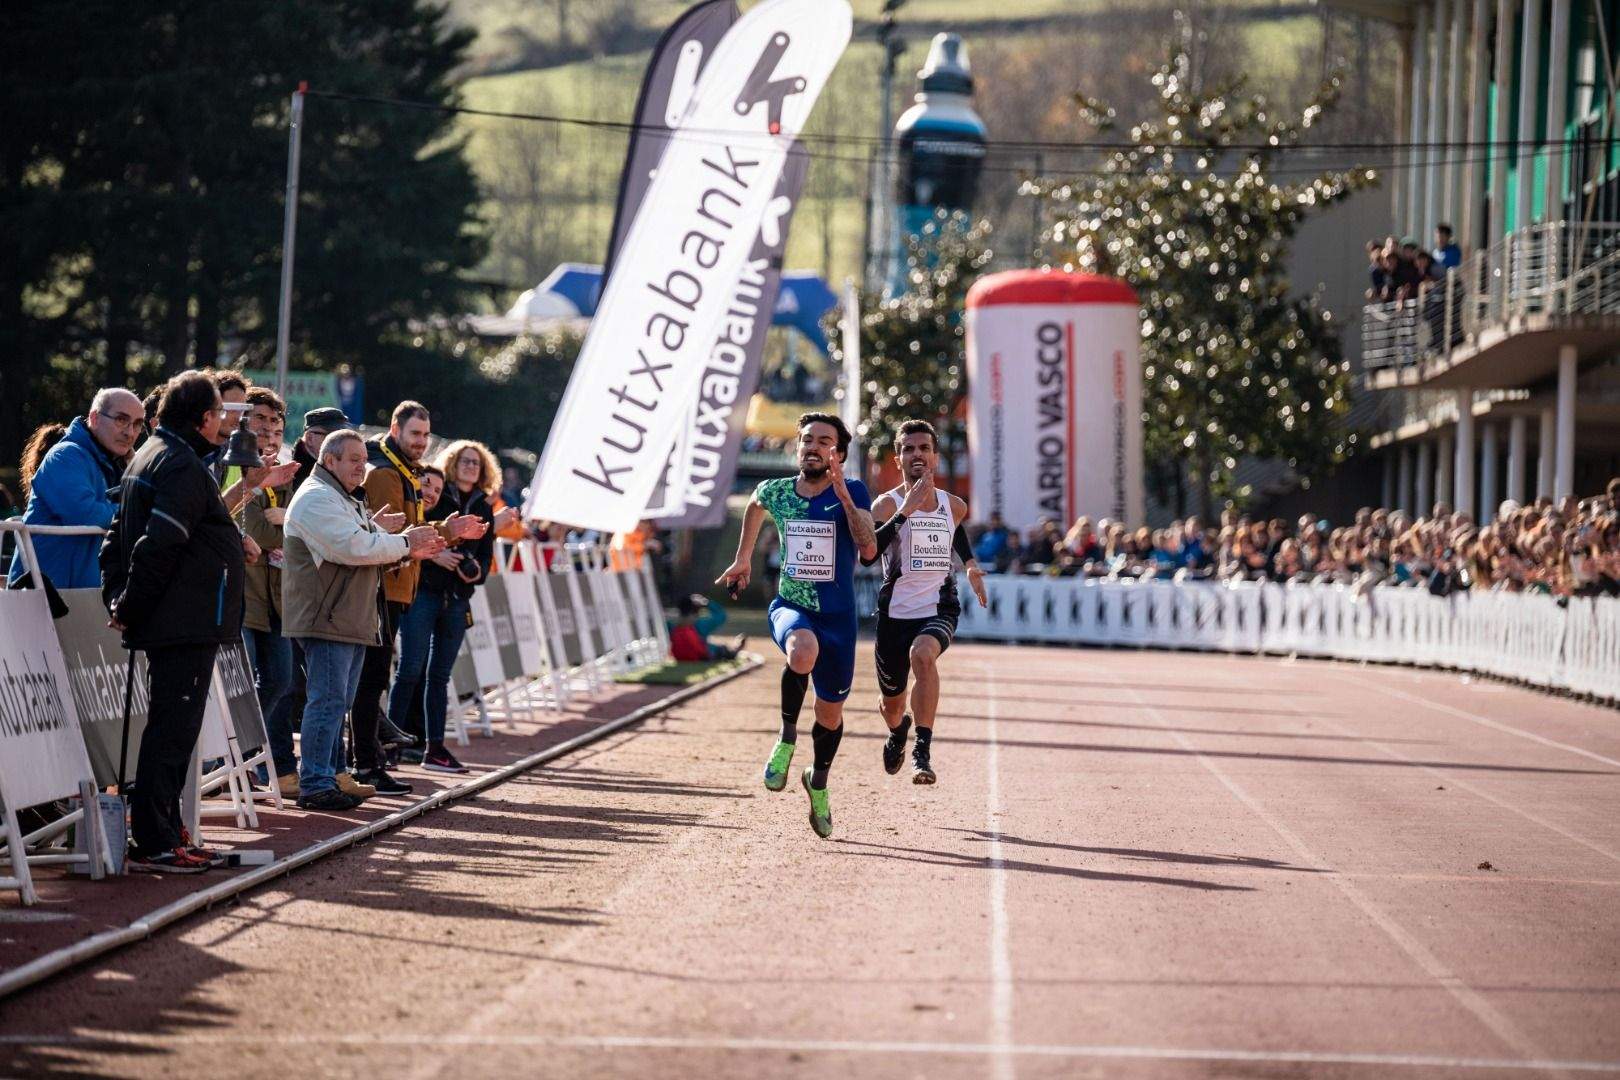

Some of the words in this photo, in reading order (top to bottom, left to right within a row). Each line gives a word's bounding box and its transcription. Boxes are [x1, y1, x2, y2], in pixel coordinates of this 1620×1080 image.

[572, 146, 759, 495] kutxabank
[1038, 323, 1062, 428] VASCO
[684, 257, 769, 508] kutxabank
[787, 524, 832, 534] kutxabank
[927, 534, 939, 543] 10
[805, 540, 813, 550] 8
[796, 551, 825, 563] Carro
[797, 568, 831, 576] DANOBAT
